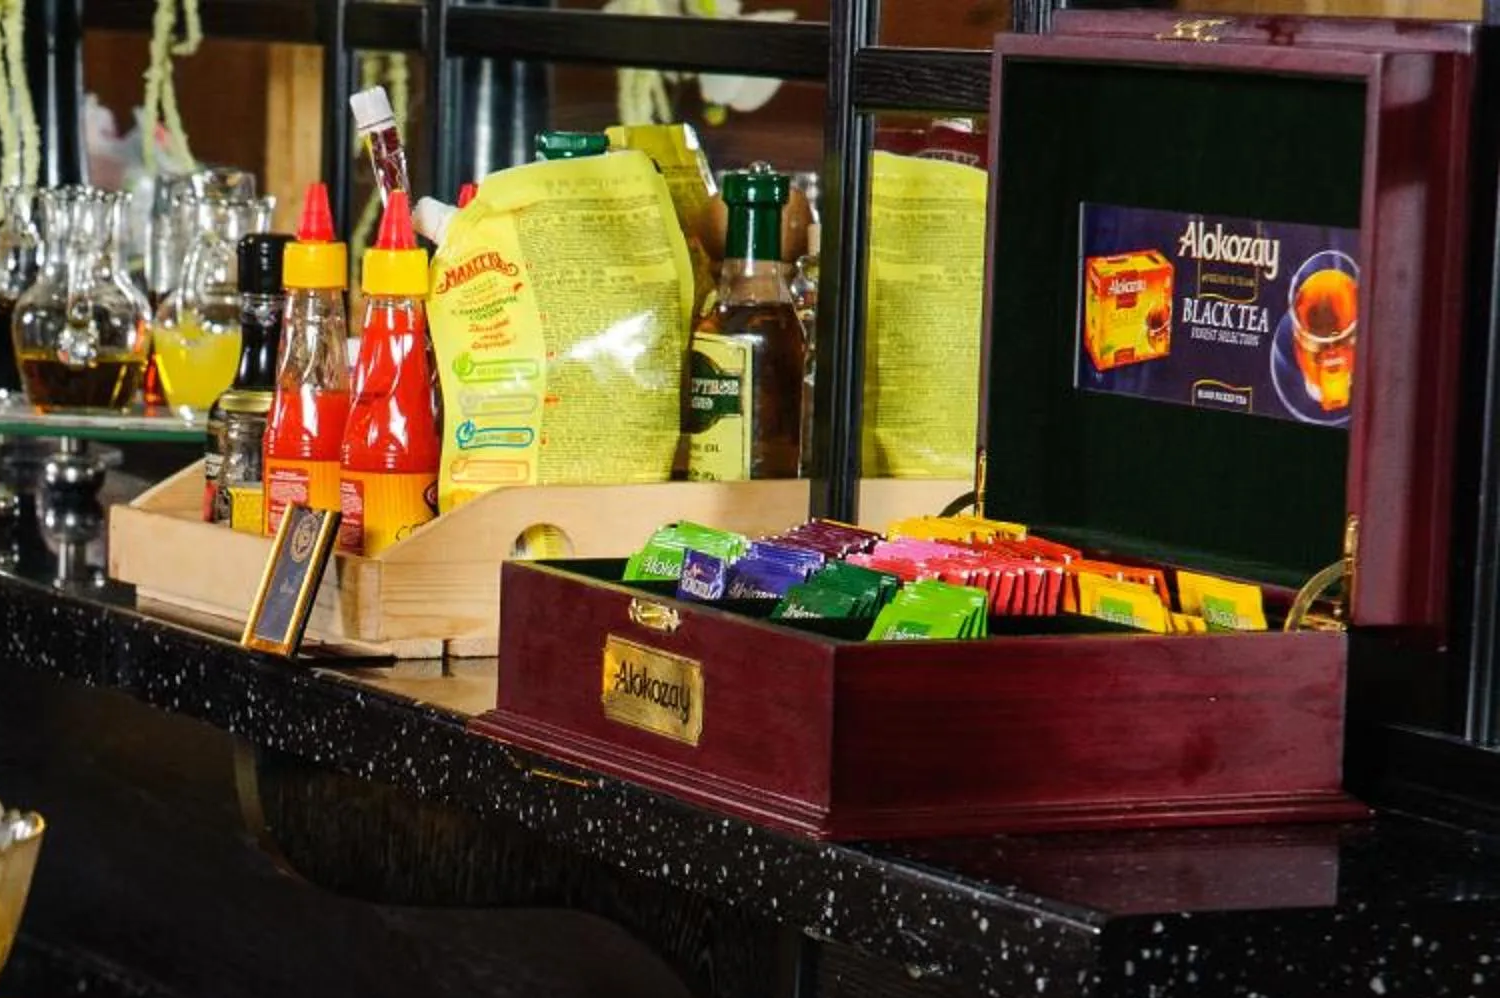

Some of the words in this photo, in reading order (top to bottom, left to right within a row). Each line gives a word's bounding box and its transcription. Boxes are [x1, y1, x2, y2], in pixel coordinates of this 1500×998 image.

[1177, 221, 1280, 280] Alokozay
[1182, 297, 1234, 329] BLACK
[1238, 305, 1268, 332] TEA
[613, 661, 690, 724] Alokozay
